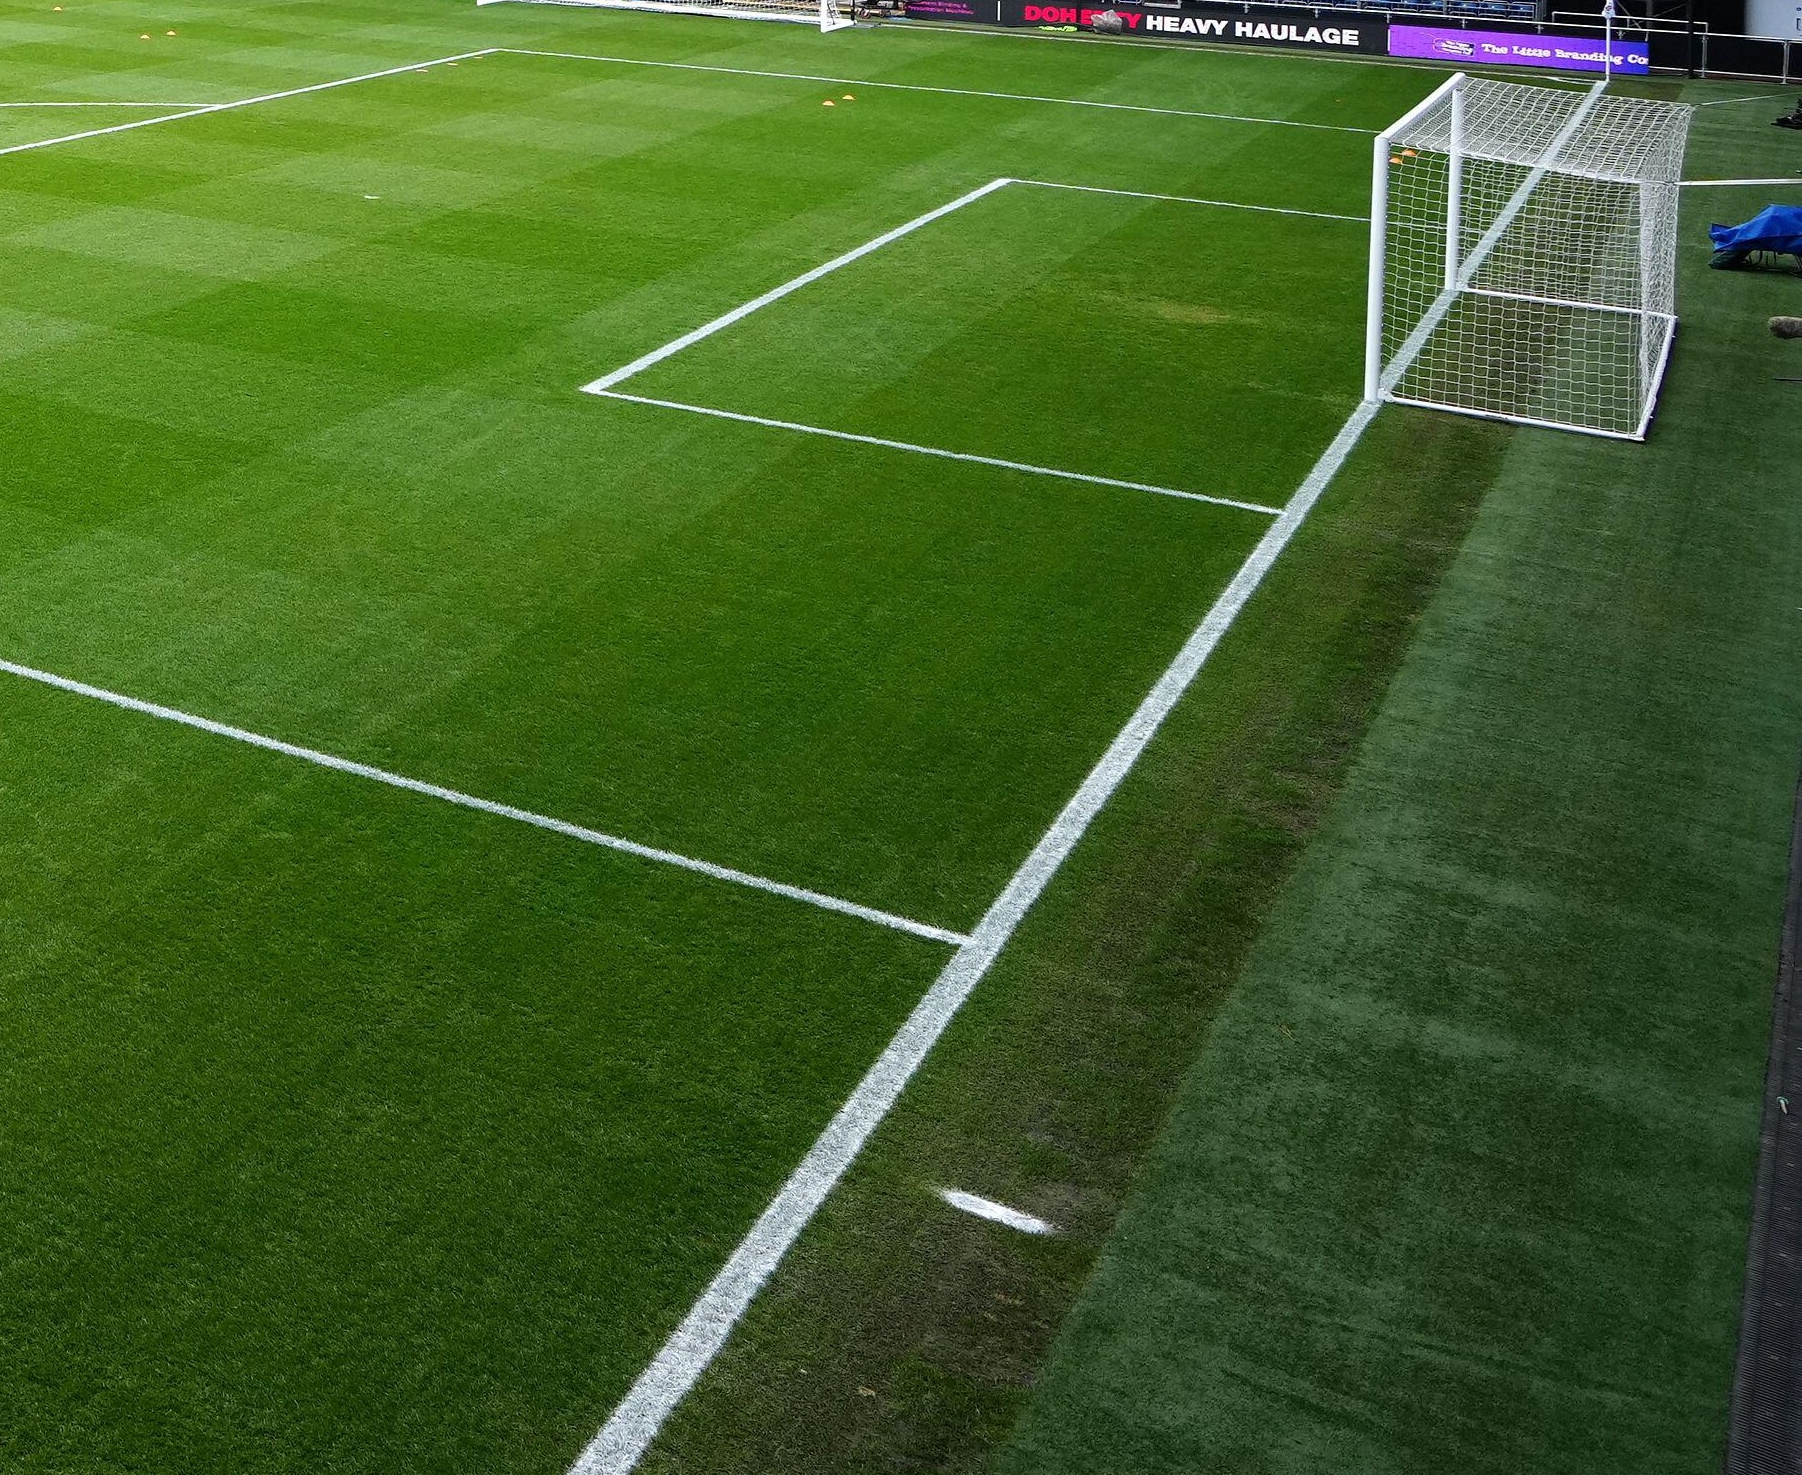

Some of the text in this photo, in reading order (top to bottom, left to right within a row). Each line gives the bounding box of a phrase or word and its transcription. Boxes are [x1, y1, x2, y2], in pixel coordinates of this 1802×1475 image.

[1024, 6, 1360, 46] DOHEY HEAVY HAULAGE
[1481, 43, 1508, 55] The
[1512, 45, 1551, 57] Little
[1555, 49, 1624, 65] Branding
